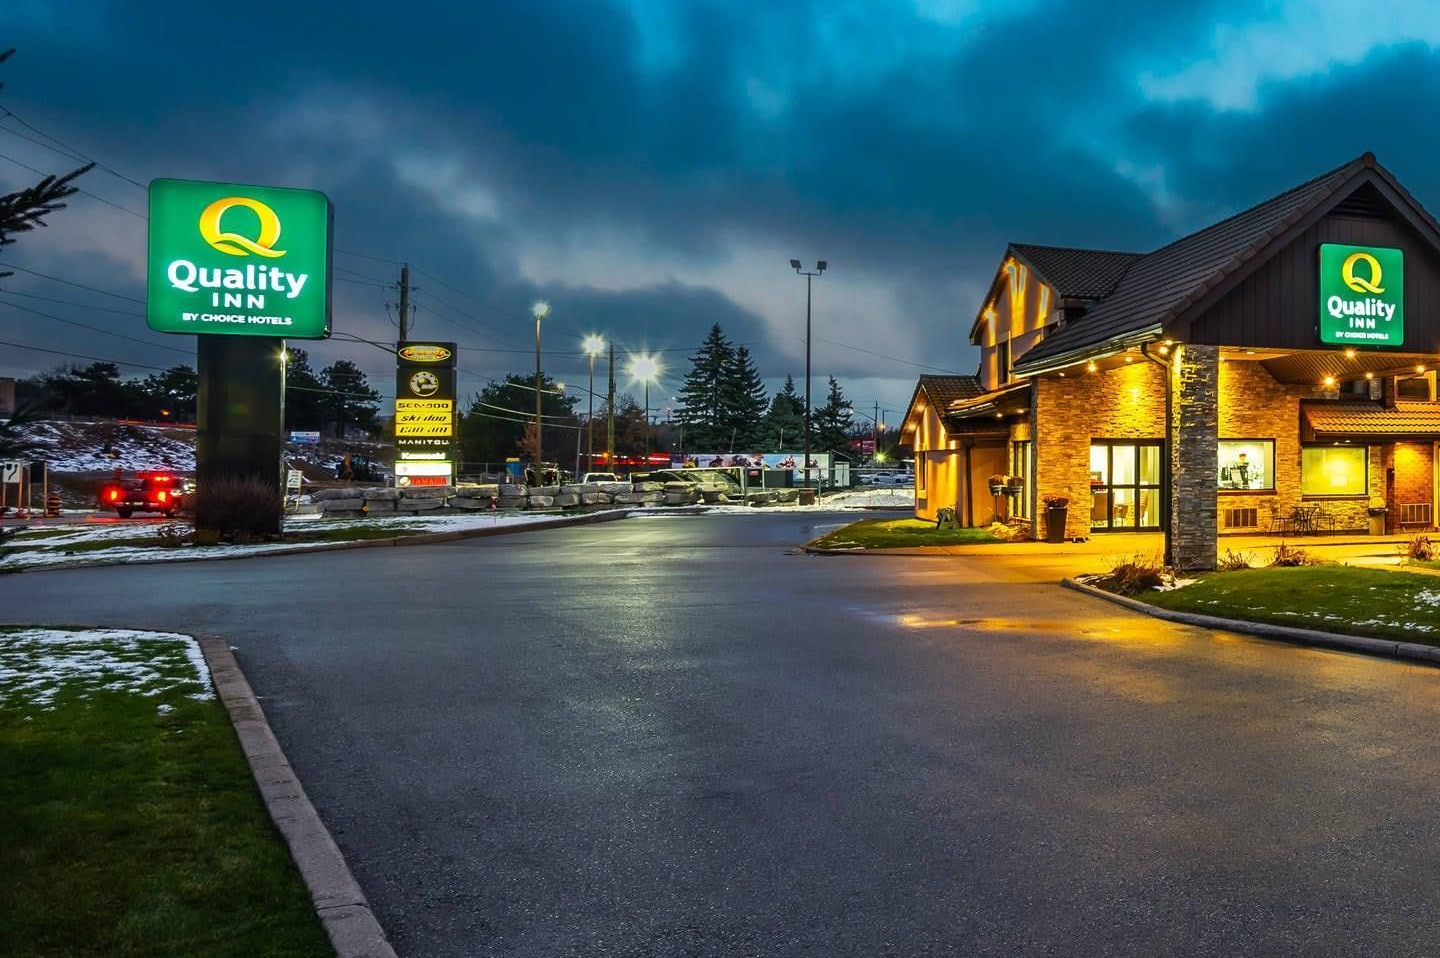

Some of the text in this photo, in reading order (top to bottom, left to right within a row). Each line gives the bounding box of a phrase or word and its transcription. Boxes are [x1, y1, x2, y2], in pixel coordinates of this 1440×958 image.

[199, 197, 287, 257] Q
[167, 259, 308, 298] Quality
[1342, 252, 1385, 294] Q
[212, 292, 265, 309] INN
[1327, 295, 1396, 322] Quality
[182, 312, 292, 325] BY CHOICE HOTELS
[1349, 317, 1376, 329] INN
